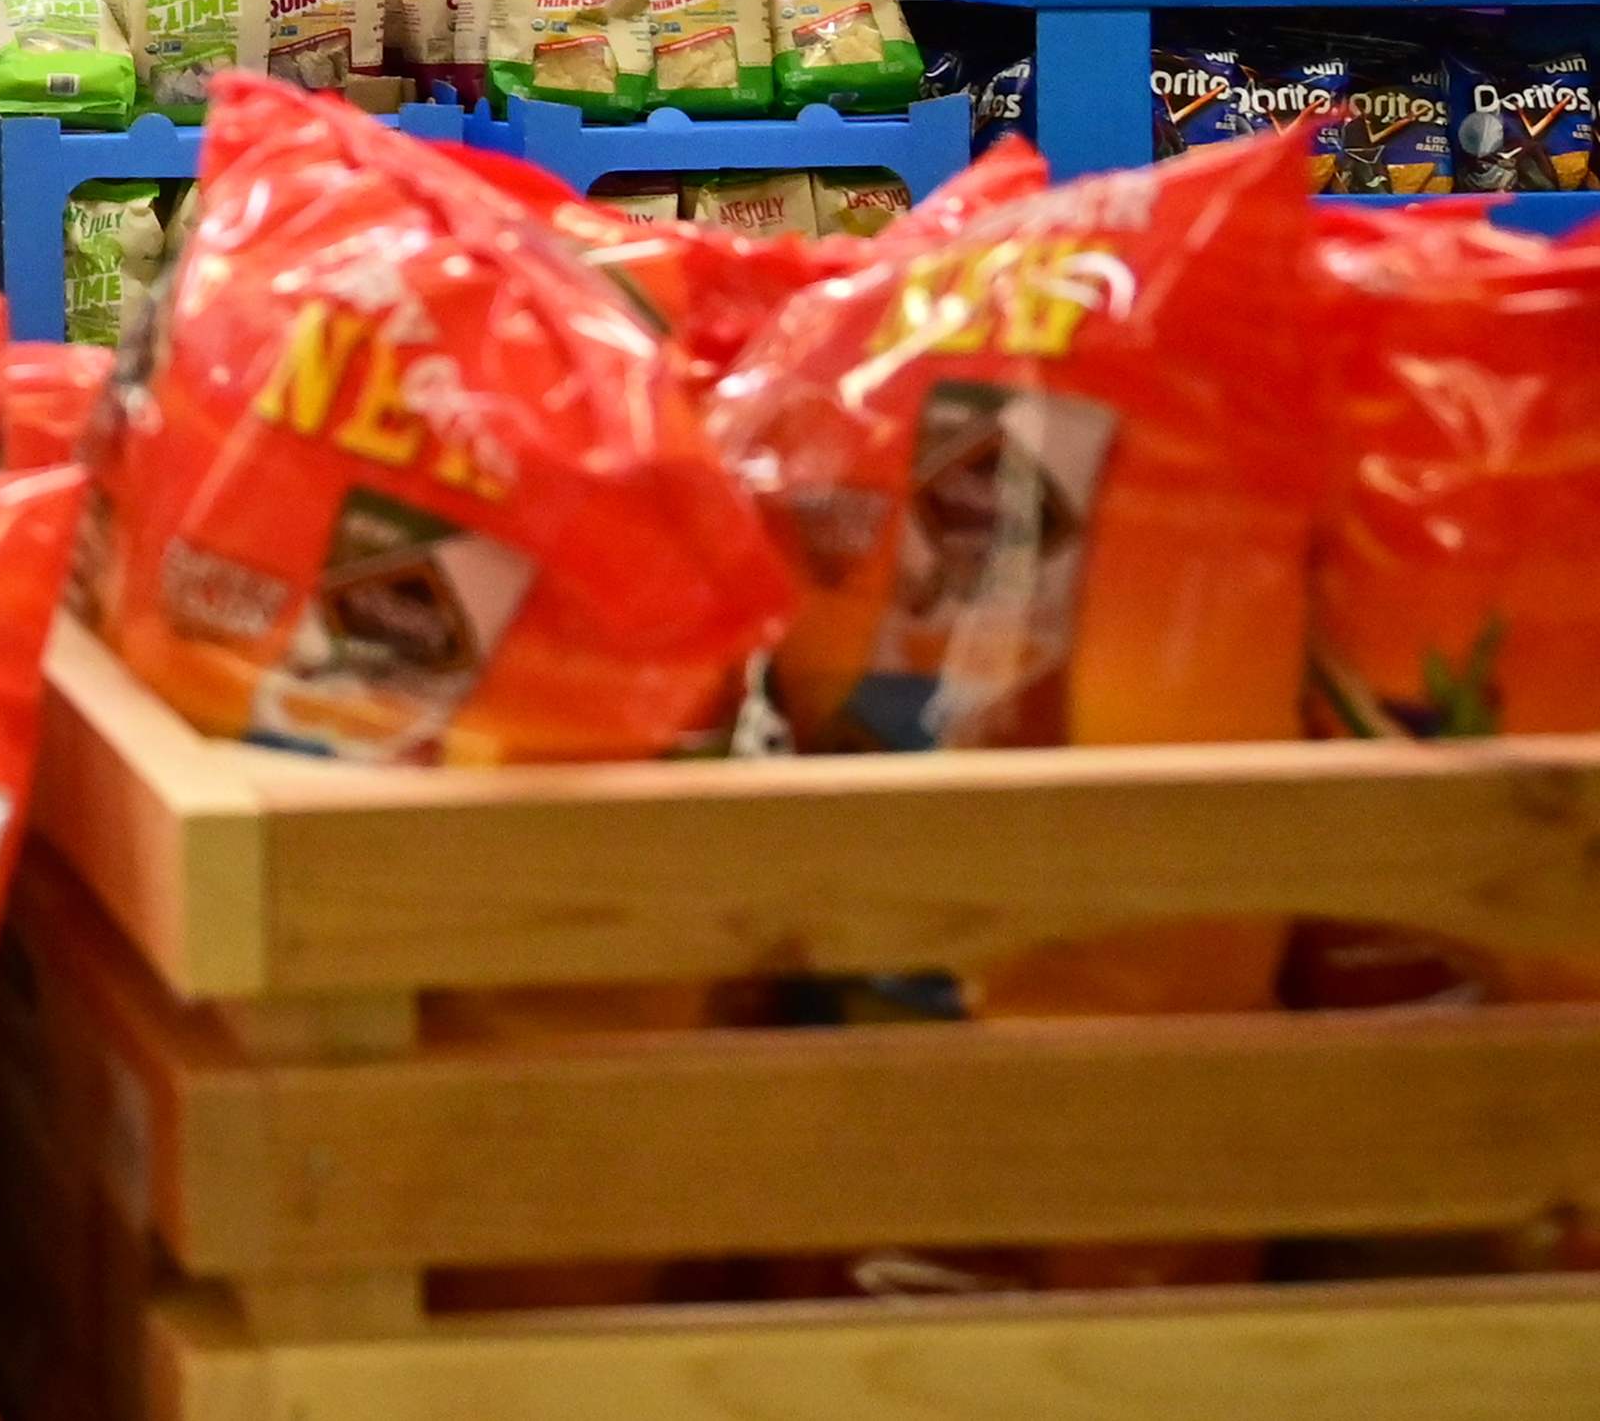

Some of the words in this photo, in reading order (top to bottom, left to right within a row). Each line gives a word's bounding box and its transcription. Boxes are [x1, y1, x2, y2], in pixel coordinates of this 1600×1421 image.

[1151, 70, 1230, 99] orito
[1473, 83, 1593, 113] Doritos
[742, 196, 786, 228] JULY
